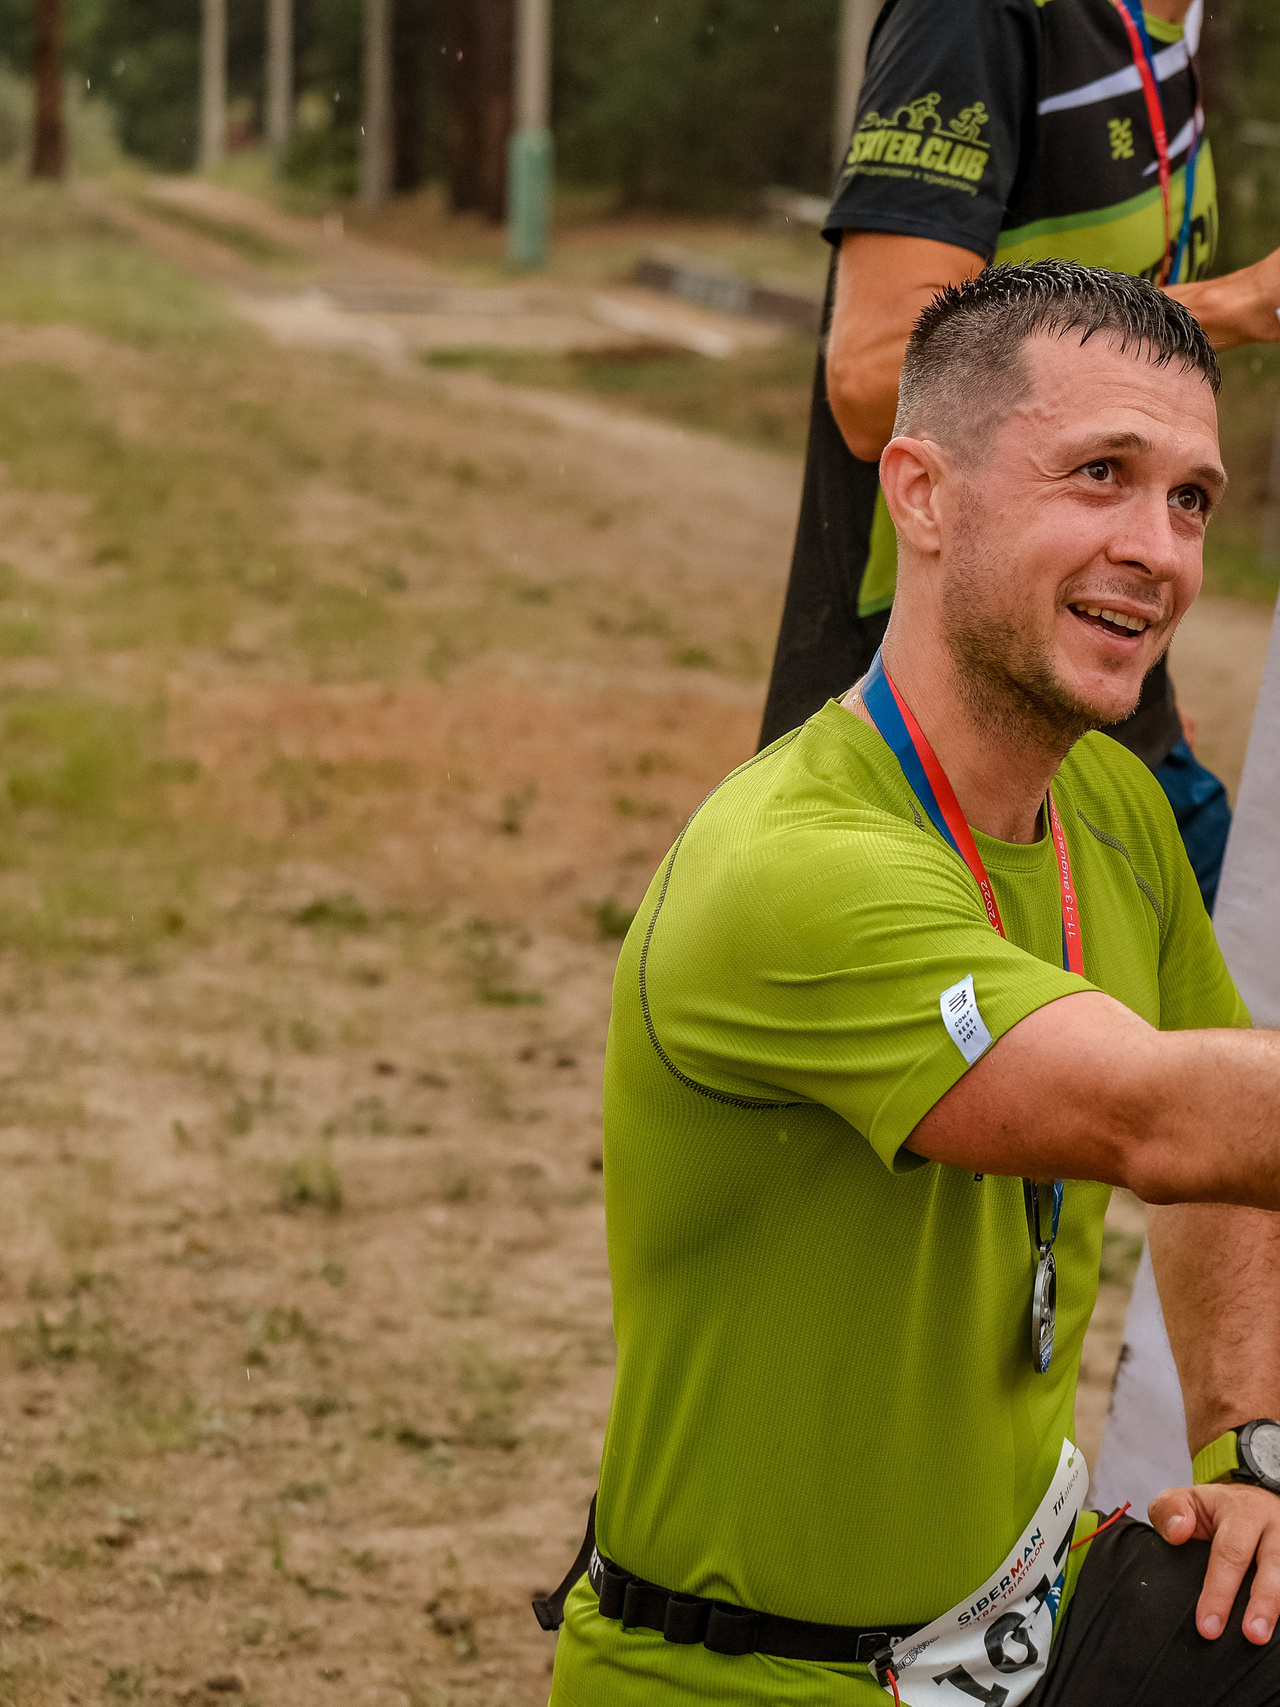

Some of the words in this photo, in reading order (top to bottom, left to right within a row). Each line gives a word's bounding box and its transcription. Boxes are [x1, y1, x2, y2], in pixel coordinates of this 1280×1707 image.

[1057, 835, 1071, 890] august
[980, 879, 997, 921] 2022
[1064, 894, 1077, 938] 11-13
[954, 1010, 970, 1028] COMP
[957, 1018, 974, 1036] RESS
[957, 1527, 1042, 1626] SIBERMAN
[1001, 1538, 1046, 1600] TRIATHLON
